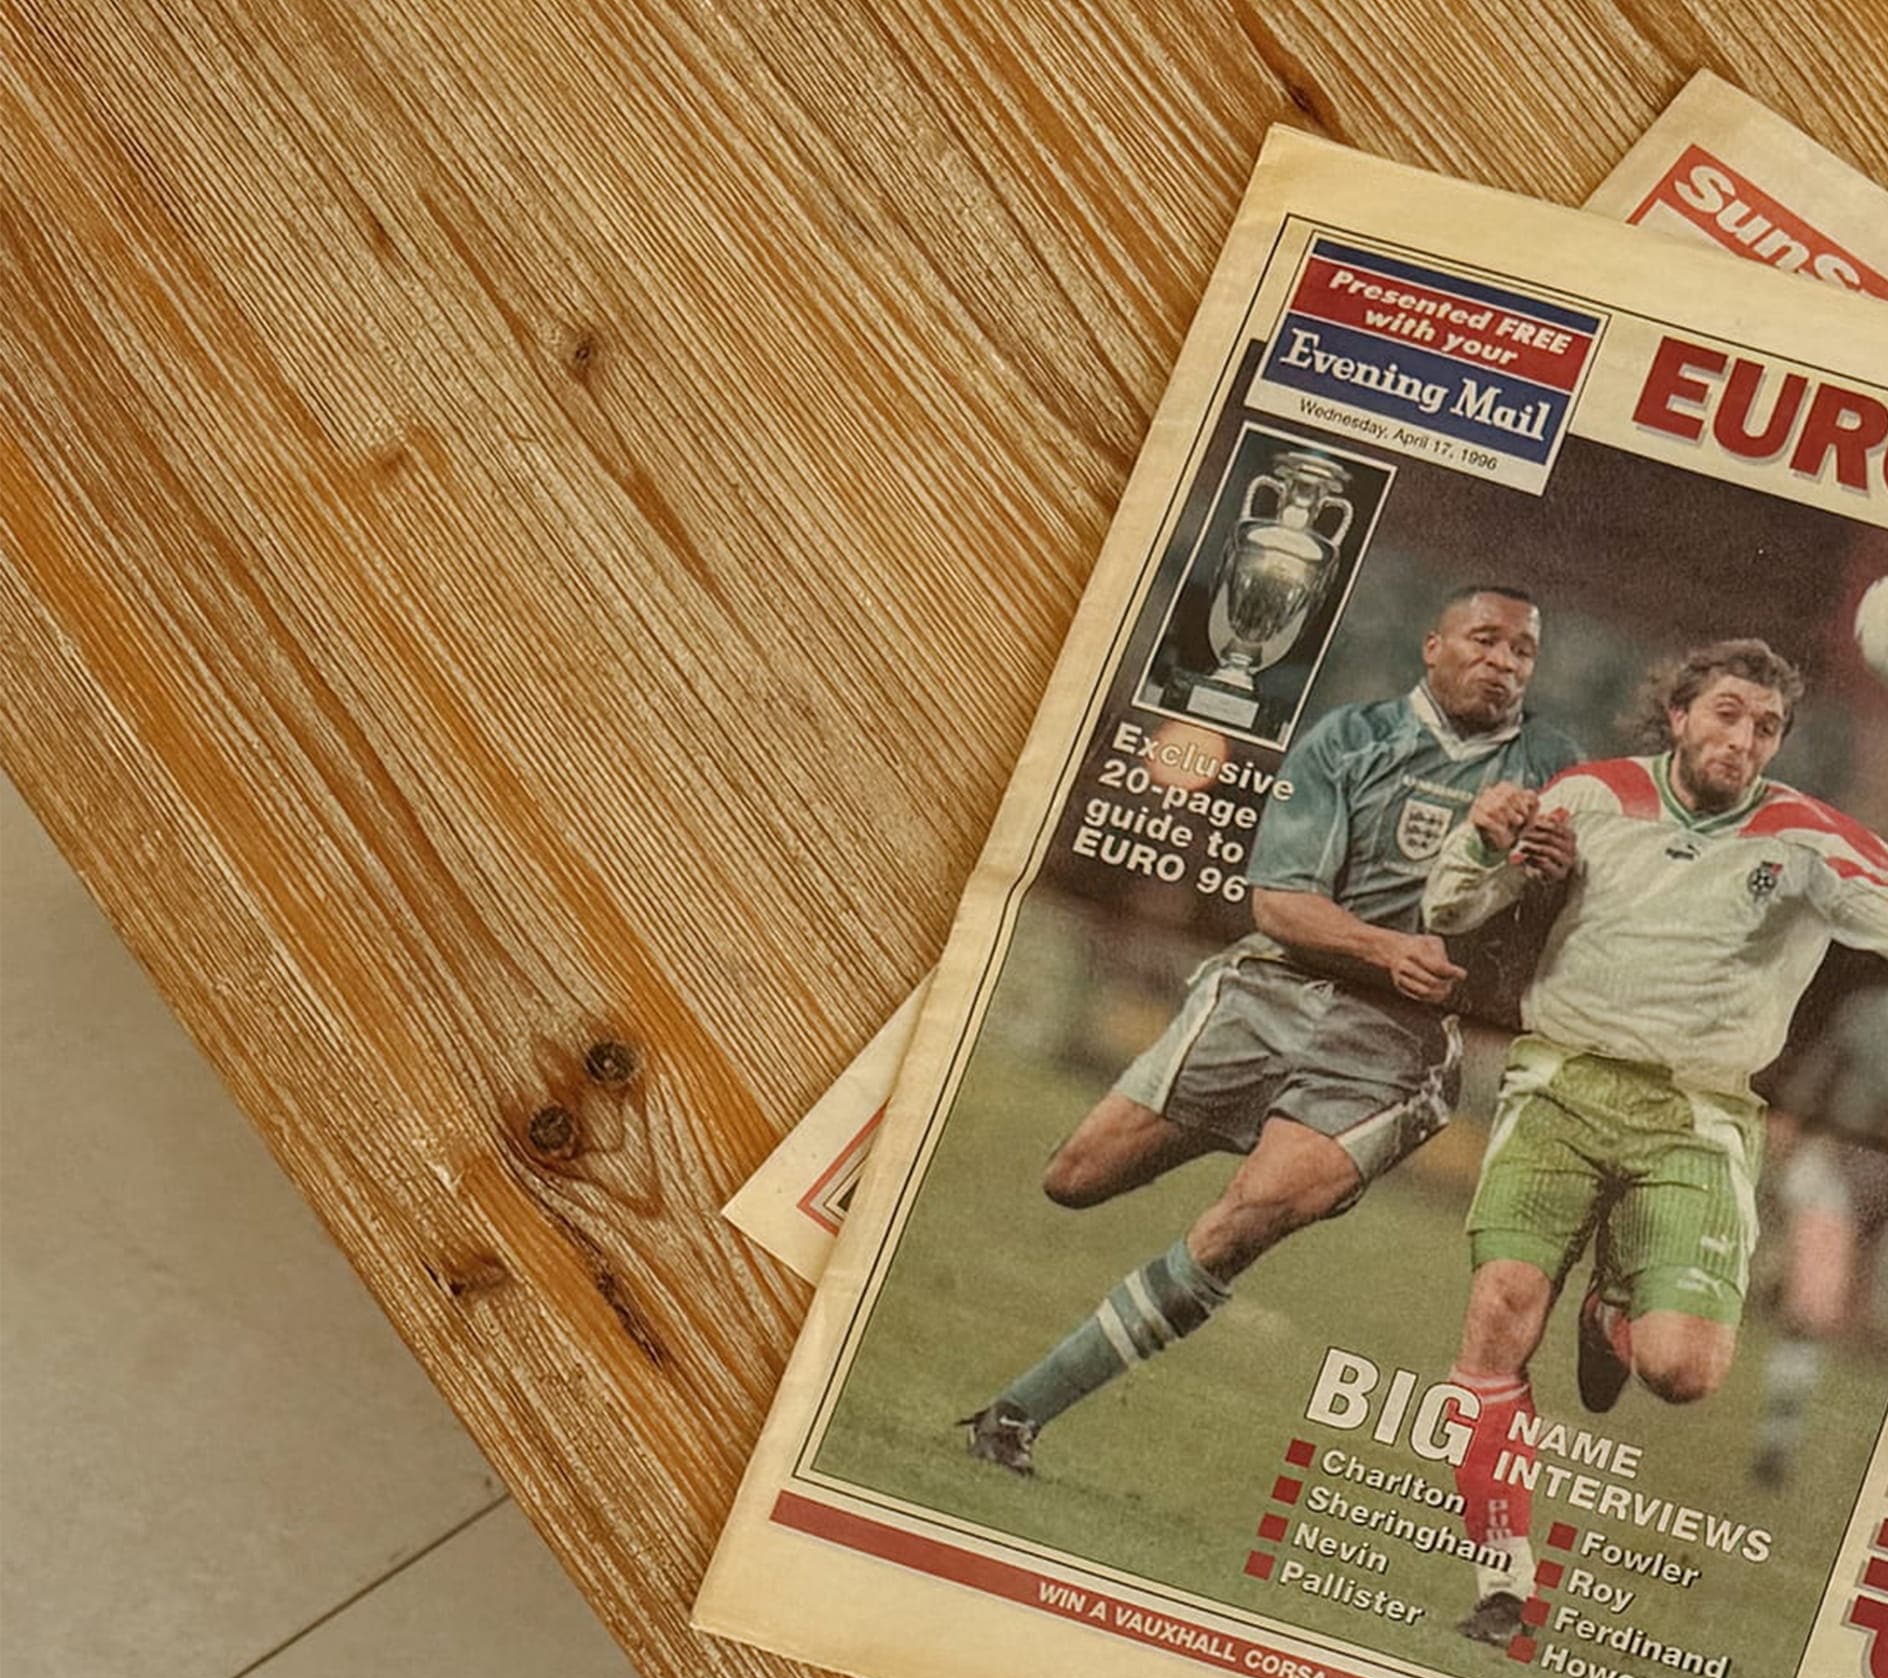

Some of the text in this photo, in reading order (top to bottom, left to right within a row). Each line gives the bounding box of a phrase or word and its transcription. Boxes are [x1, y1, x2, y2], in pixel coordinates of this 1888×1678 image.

[1674, 165, 1870, 294] SunS
[1329, 270, 1573, 355] Presented FREE
[1365, 309, 1518, 366] with your
[1280, 327, 1553, 442] Evening Mail
[1299, 396, 1498, 471] Wednesday, April 17, 1996
[1098, 758, 1259, 829] 20-page
[1112, 721, 1296, 801] Exclusive
[1072, 826, 1250, 902] EURO 96
[1083, 797, 1245, 864] guide to
[1305, 1346, 1483, 1468] BIG
[1506, 1410, 1645, 1480] NAME
[1320, 1449, 1467, 1517] Charlton
[1493, 1450, 1774, 1564] INTERVIEWS
[1292, 1522, 1391, 1576] Nevin
[1305, 1486, 1514, 1574] Sheringham
[1580, 1531, 1701, 1591] Fowler
[1038, 1581, 1088, 1614] WIN
[1089, 1600, 1109, 1621] A
[1115, 1607, 1238, 1663] VAUXHALL
[1279, 1560, 1426, 1628] Pallister
[1567, 1567, 1636, 1616] Roy
